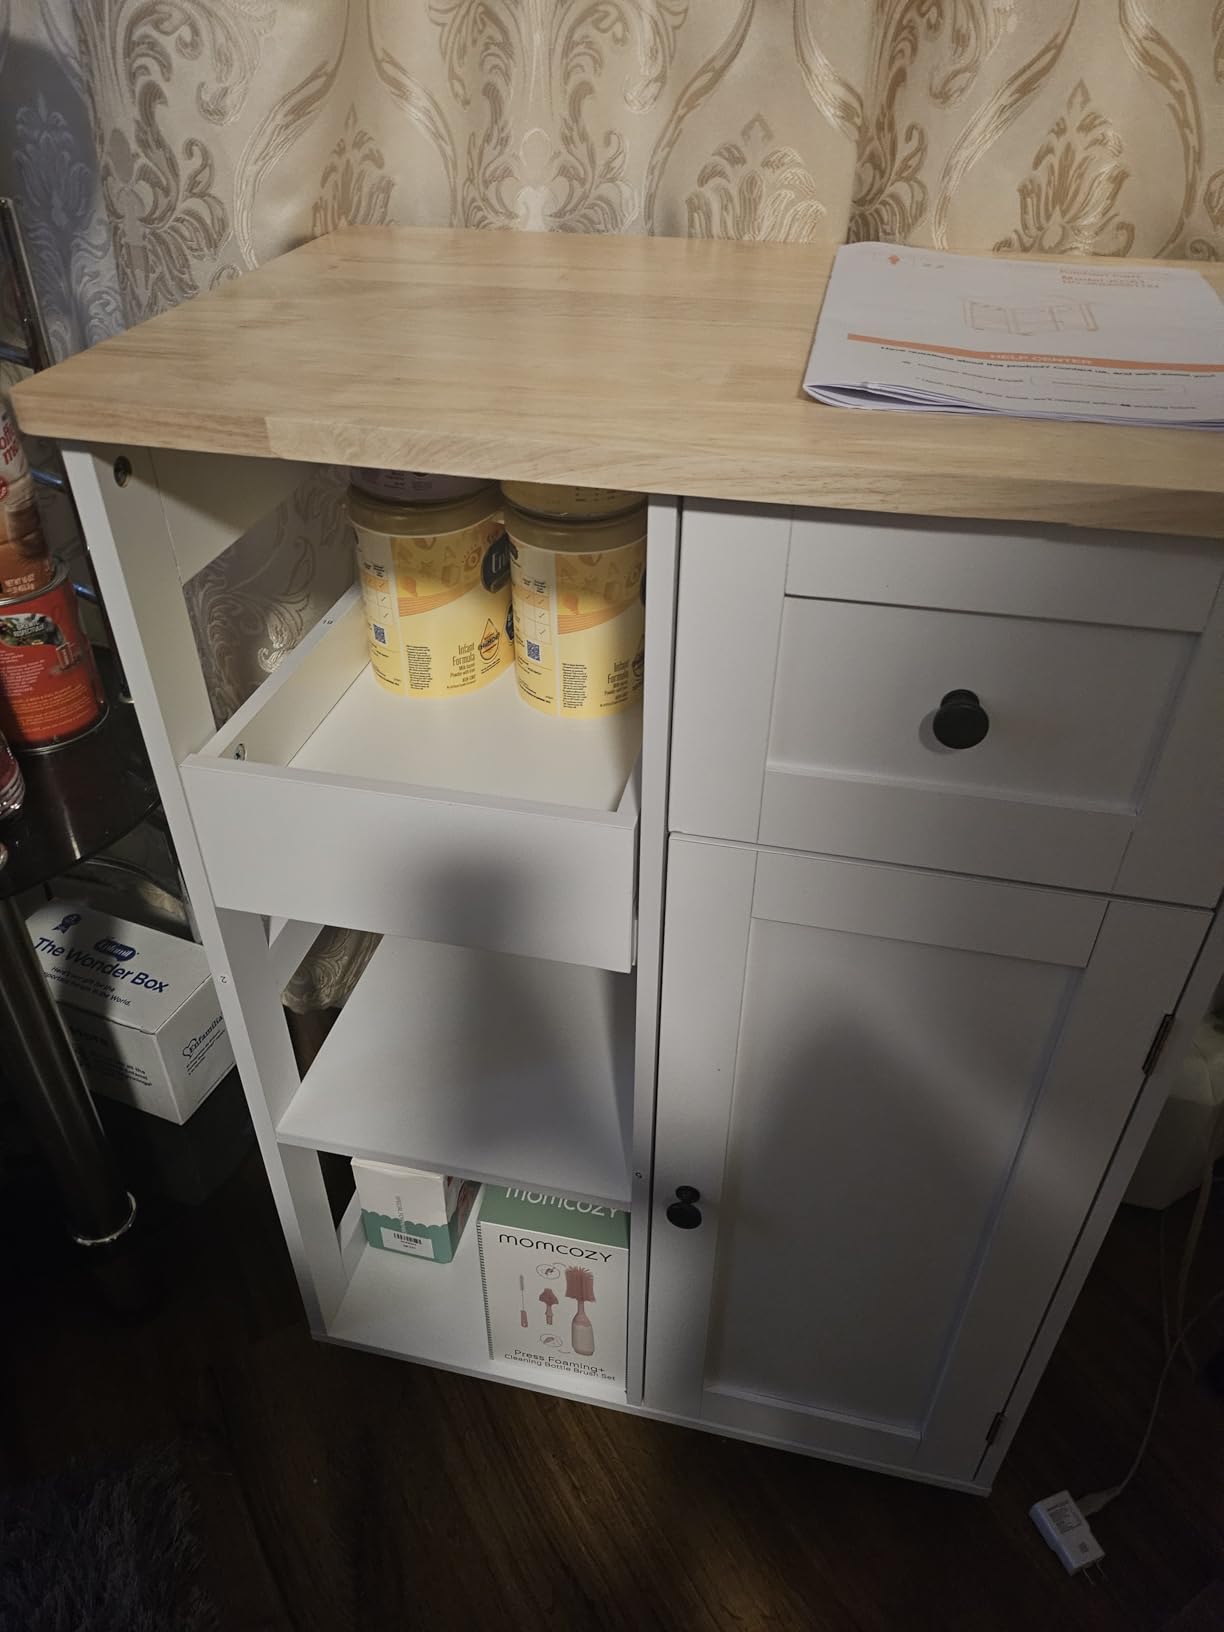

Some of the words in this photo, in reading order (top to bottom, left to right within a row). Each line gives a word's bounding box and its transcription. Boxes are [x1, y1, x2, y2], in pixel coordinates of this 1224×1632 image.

[452, 653, 475, 667] Formula
[34, 937, 65, 957] The
[66, 947, 134, 980] Wonder
[131, 972, 169, 993] Box
[504, 1353, 542, 1367] Cleaning
[544, 1360, 571, 1373] Bottle
[572, 1365, 600, 1378] Brush
[600, 1371, 616, 1382] Set
[514, 1348, 545, 1362] Press
[547, 1355, 606, 1374] Foaming+
